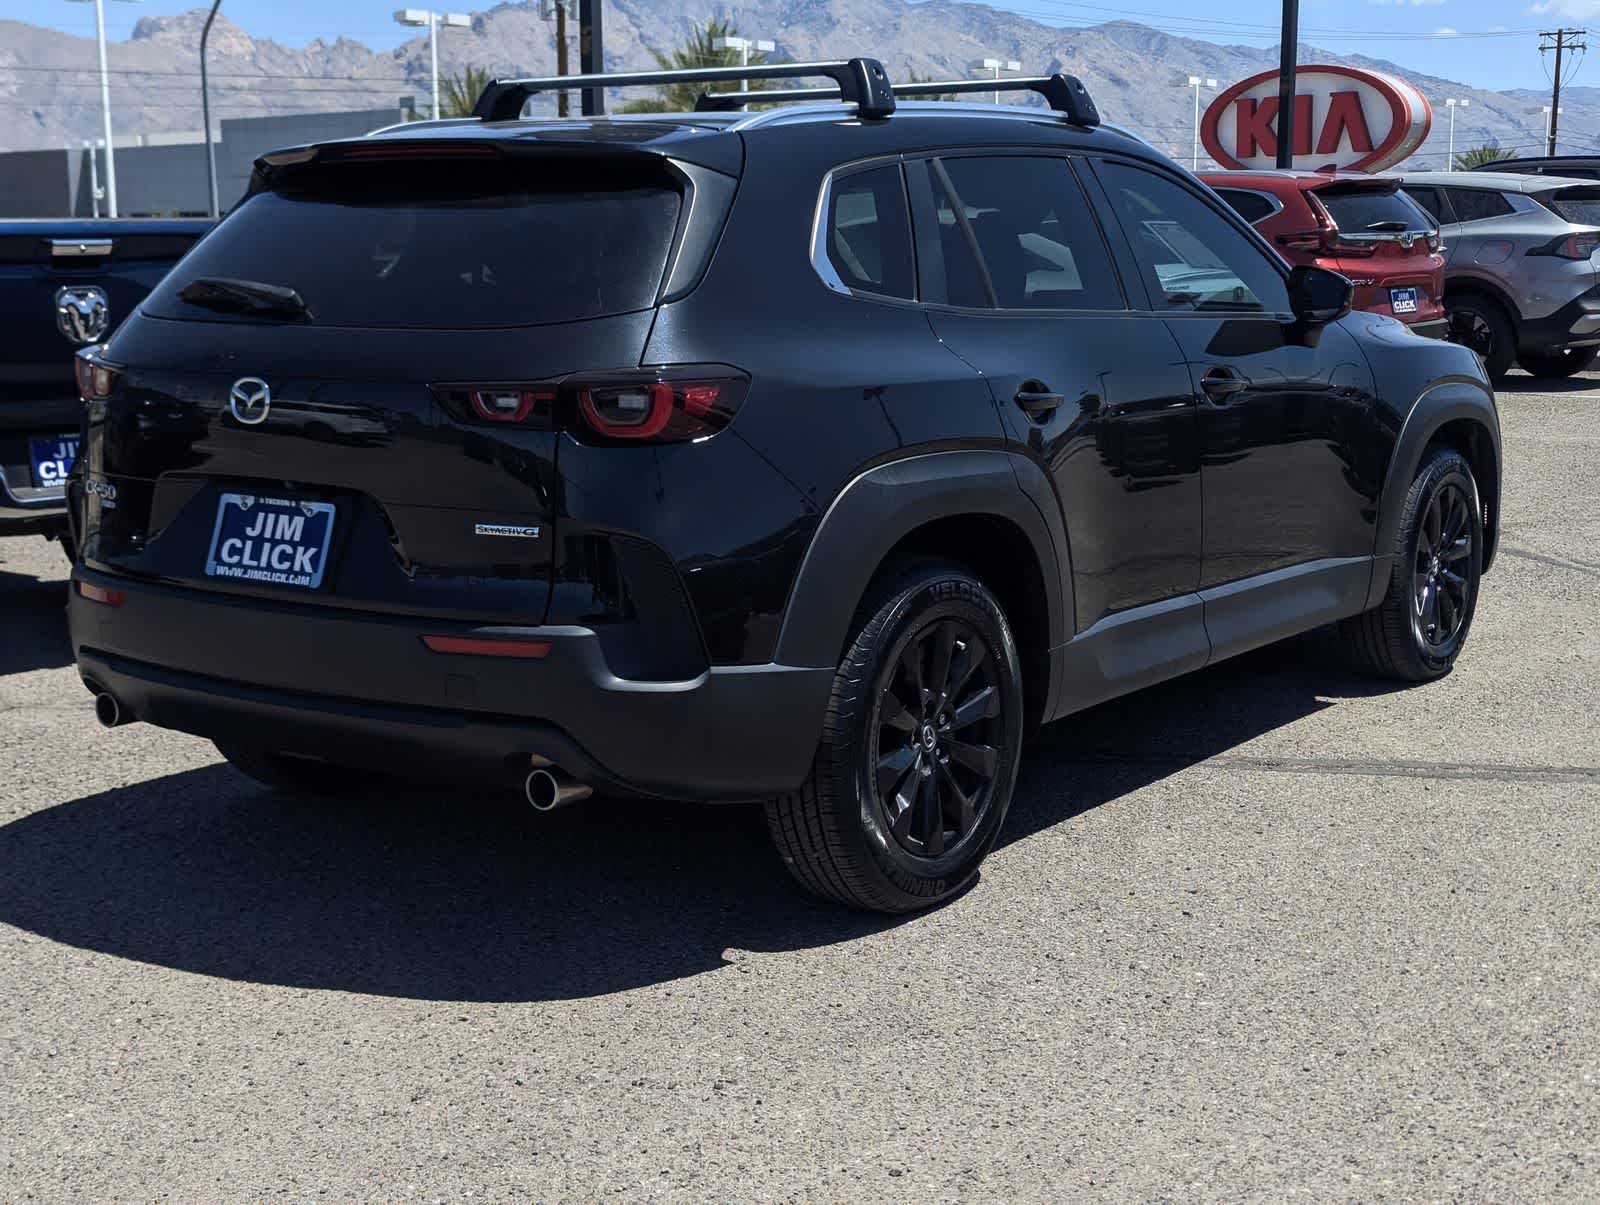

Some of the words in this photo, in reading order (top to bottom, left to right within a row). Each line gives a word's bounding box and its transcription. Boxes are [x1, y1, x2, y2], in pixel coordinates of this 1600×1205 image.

[1234, 91, 1376, 158] KIA
[1394, 300, 1415, 309] CLICK
[52, 441, 80, 459] JI
[245, 511, 305, 542] JIM
[220, 537, 319, 574] CLICK
